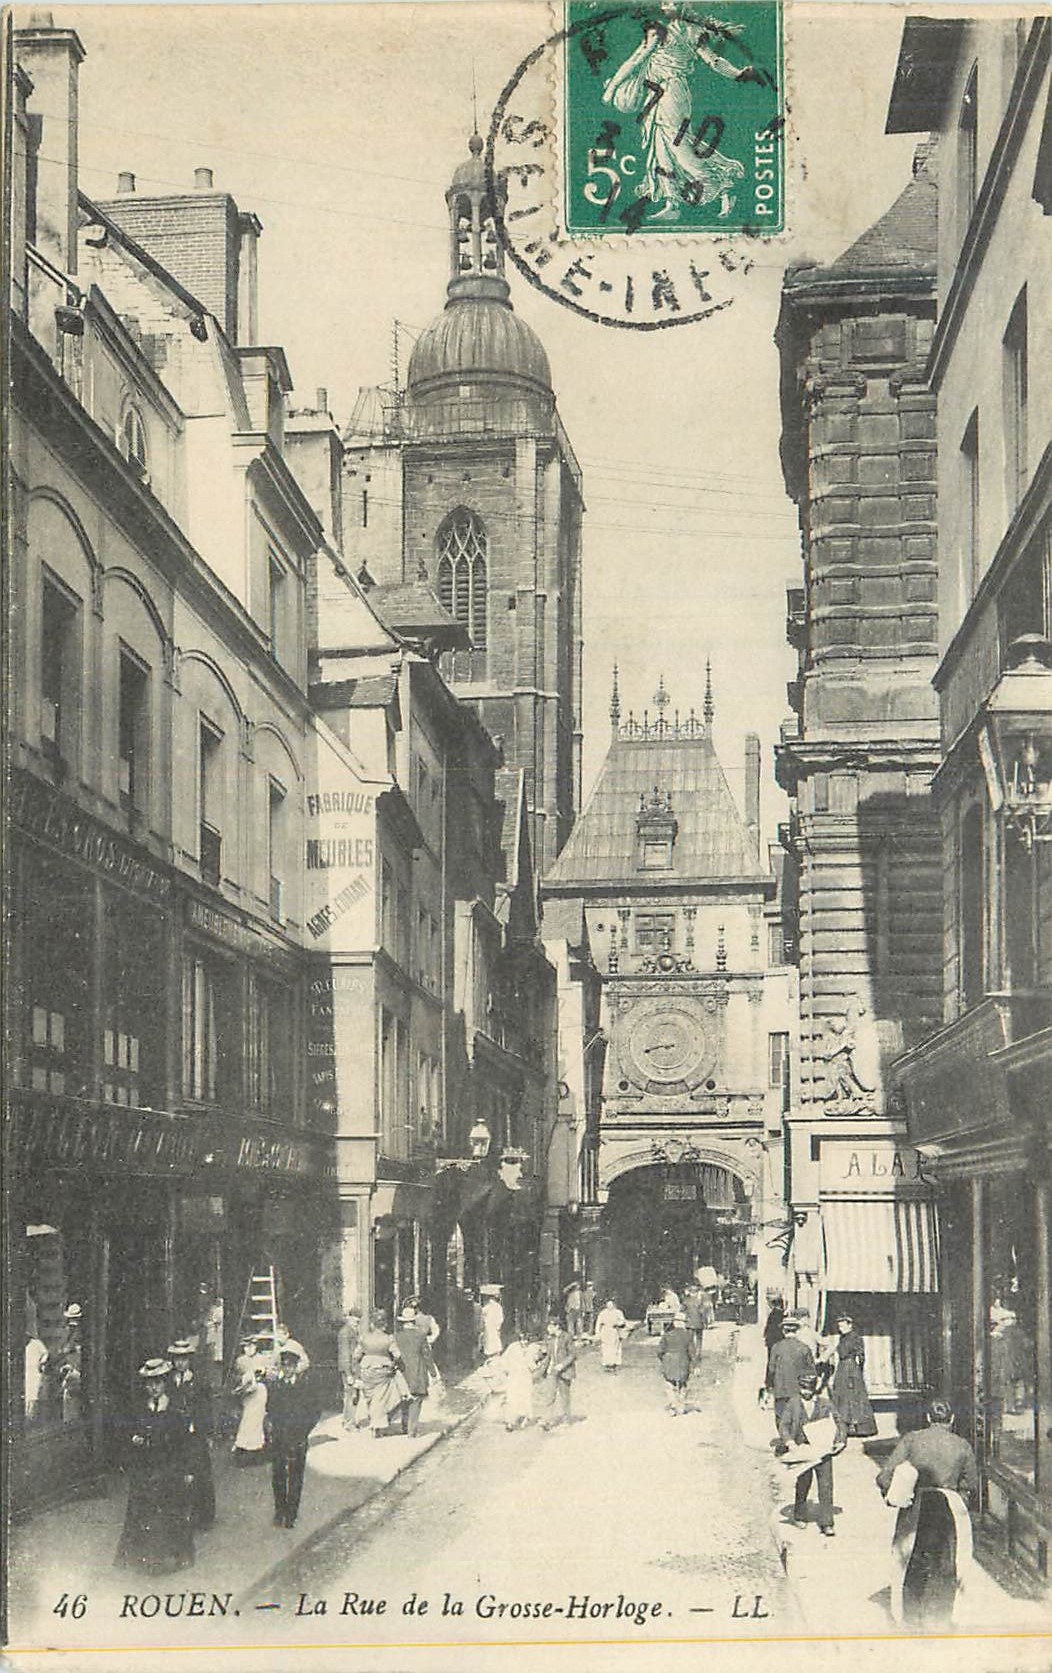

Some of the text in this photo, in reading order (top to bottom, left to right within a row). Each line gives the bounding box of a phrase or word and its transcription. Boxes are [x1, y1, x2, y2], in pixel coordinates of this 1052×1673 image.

[755, 130, 774, 216] POSTES
[306, 792, 373, 817] FABRIQUE
[306, 838, 373, 870] MEUBLES
